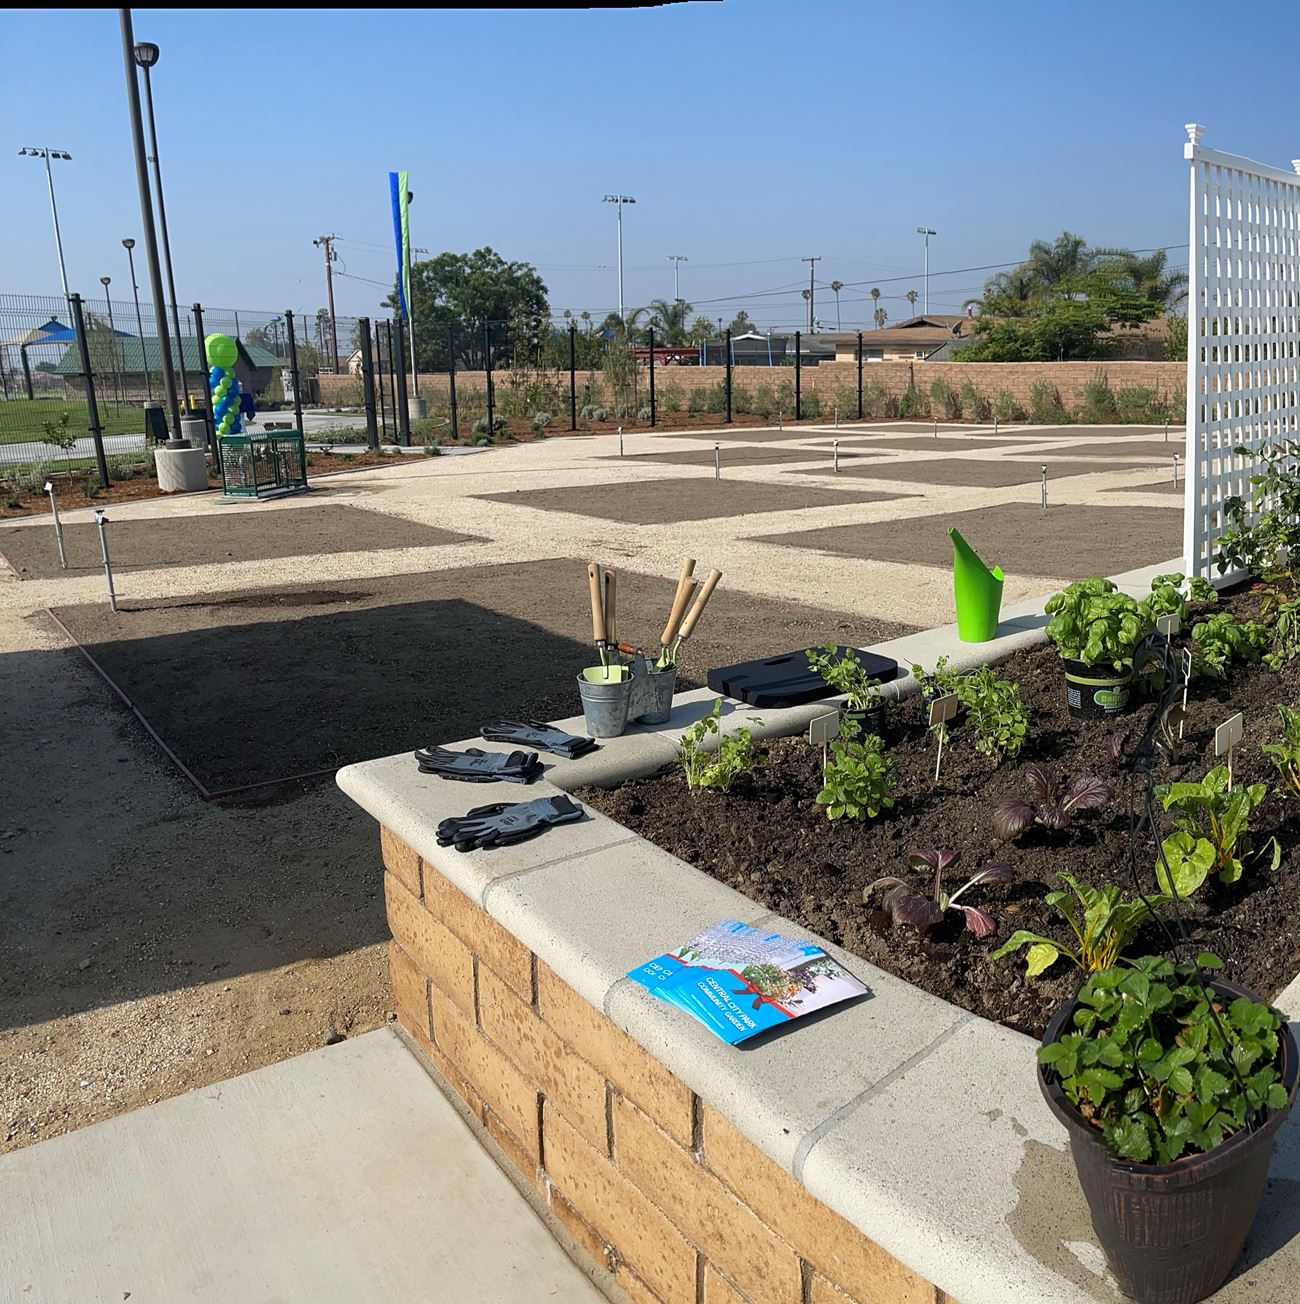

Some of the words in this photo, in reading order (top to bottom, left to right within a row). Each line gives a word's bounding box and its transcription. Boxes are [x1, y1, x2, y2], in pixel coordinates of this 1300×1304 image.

[697, 981, 727, 1011] COMMUNITY
[724, 1011, 746, 1032] GARDEN
[706, 976, 731, 1003] CENTRAL
[727, 1001, 743, 1015] CITY
[739, 1012, 758, 1029] PARK
